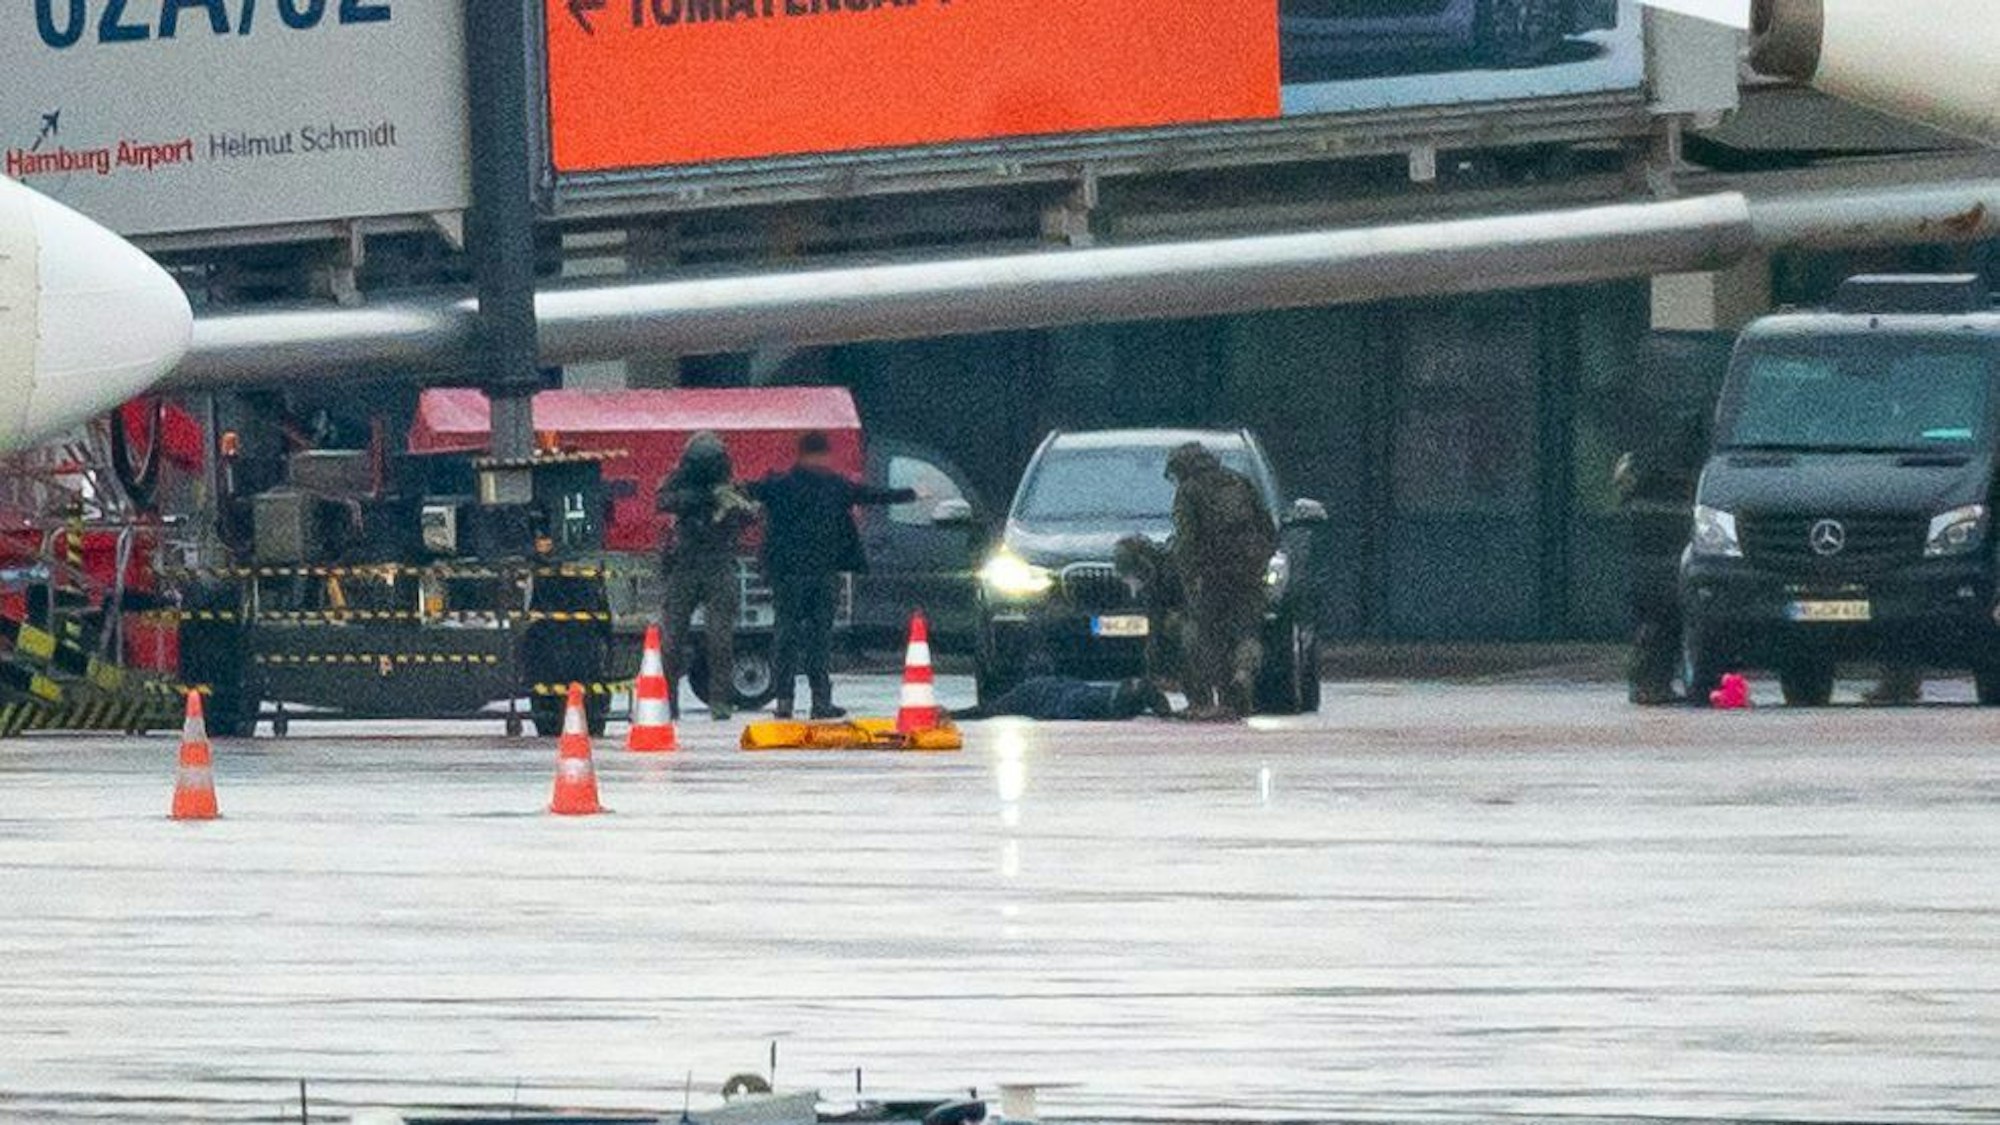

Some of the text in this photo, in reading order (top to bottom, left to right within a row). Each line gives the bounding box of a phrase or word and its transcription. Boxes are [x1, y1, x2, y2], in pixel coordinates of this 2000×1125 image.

[7, 121, 397, 176] Hamburg Airport Helmut Schmidt
